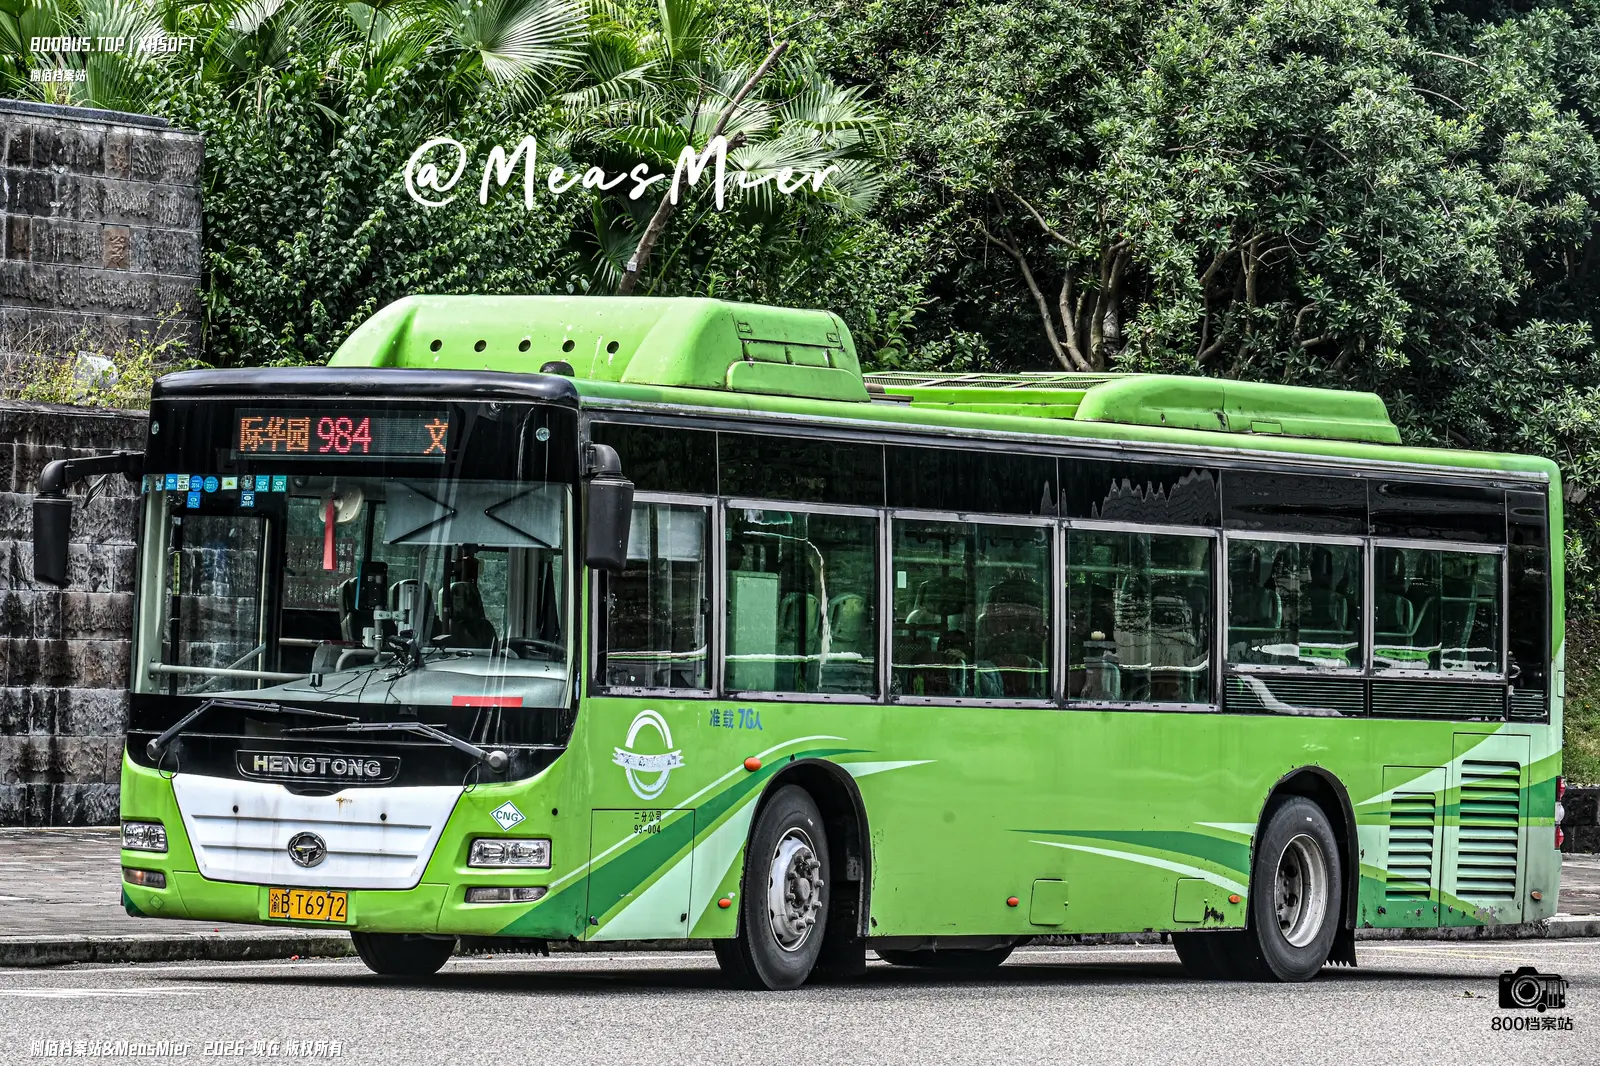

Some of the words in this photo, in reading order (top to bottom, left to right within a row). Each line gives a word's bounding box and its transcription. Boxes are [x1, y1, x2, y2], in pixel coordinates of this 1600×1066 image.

[240, 416, 310, 452] 际华园
[317, 417, 372, 453] 984
[253, 755, 381, 777] HENGTONG
[495, 810, 519, 822] CNG
[633, 810, 663, 823] 二分公司
[633, 824, 662, 835] 93-004
